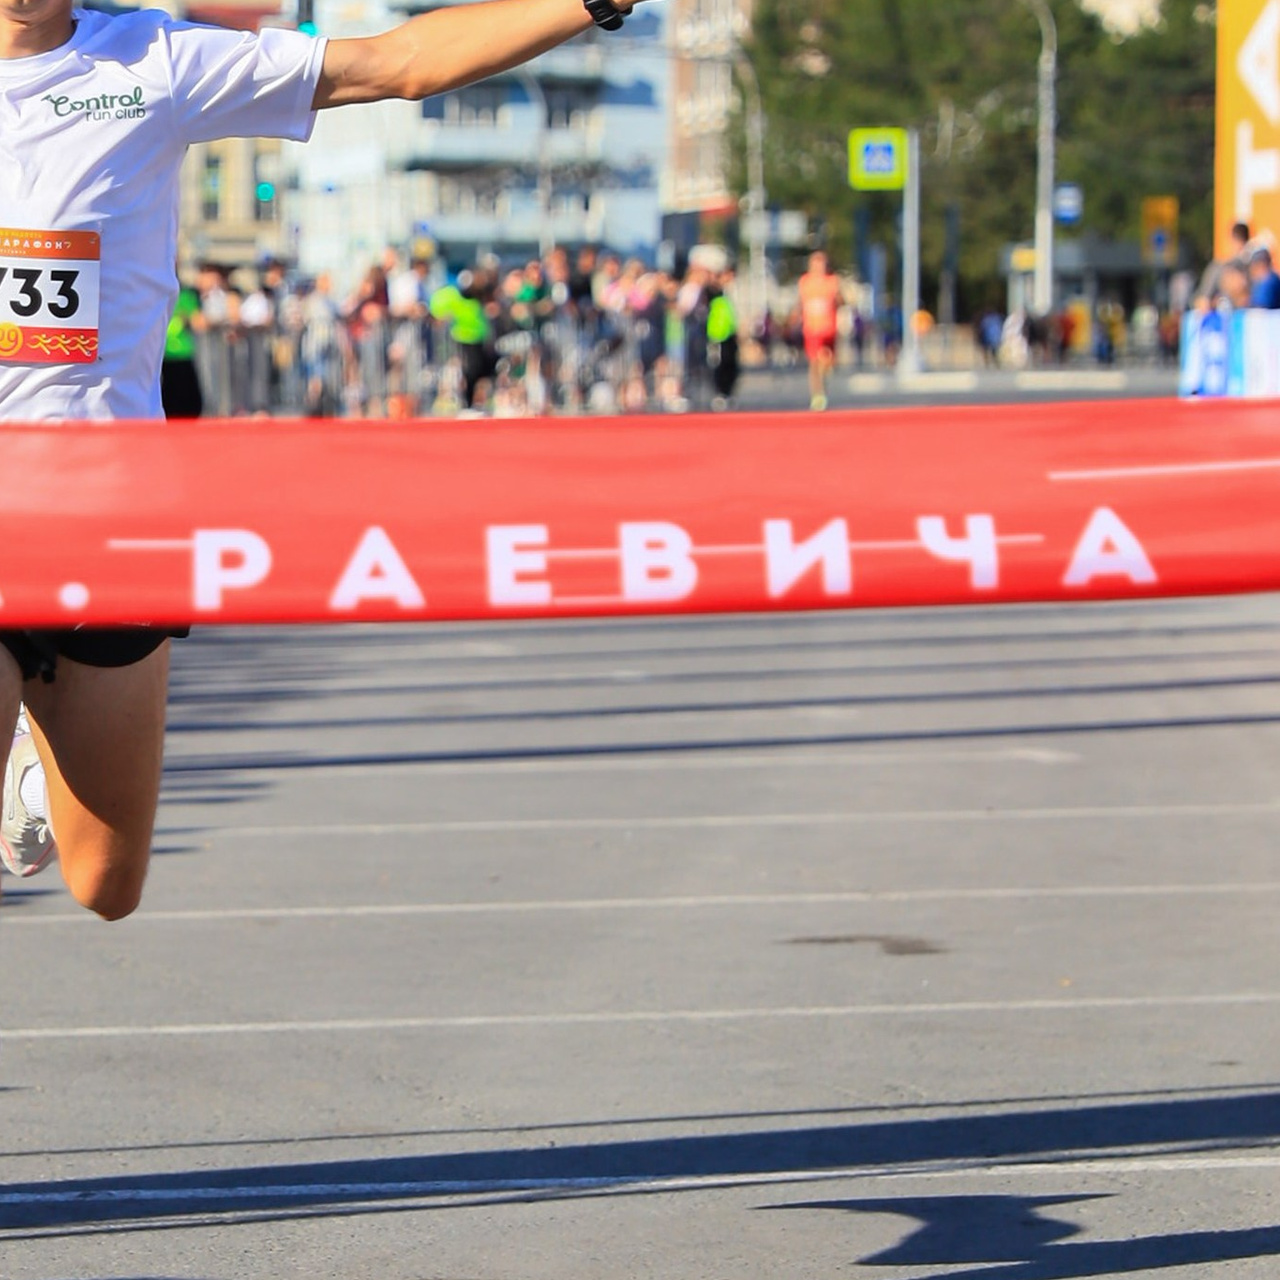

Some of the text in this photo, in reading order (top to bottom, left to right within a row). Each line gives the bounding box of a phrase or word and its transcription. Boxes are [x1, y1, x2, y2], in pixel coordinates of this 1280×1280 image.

[48, 86, 145, 117] Control
[85, 107, 146, 122] run club
[190, 506, 1160, 612] РАЕВИЧА
